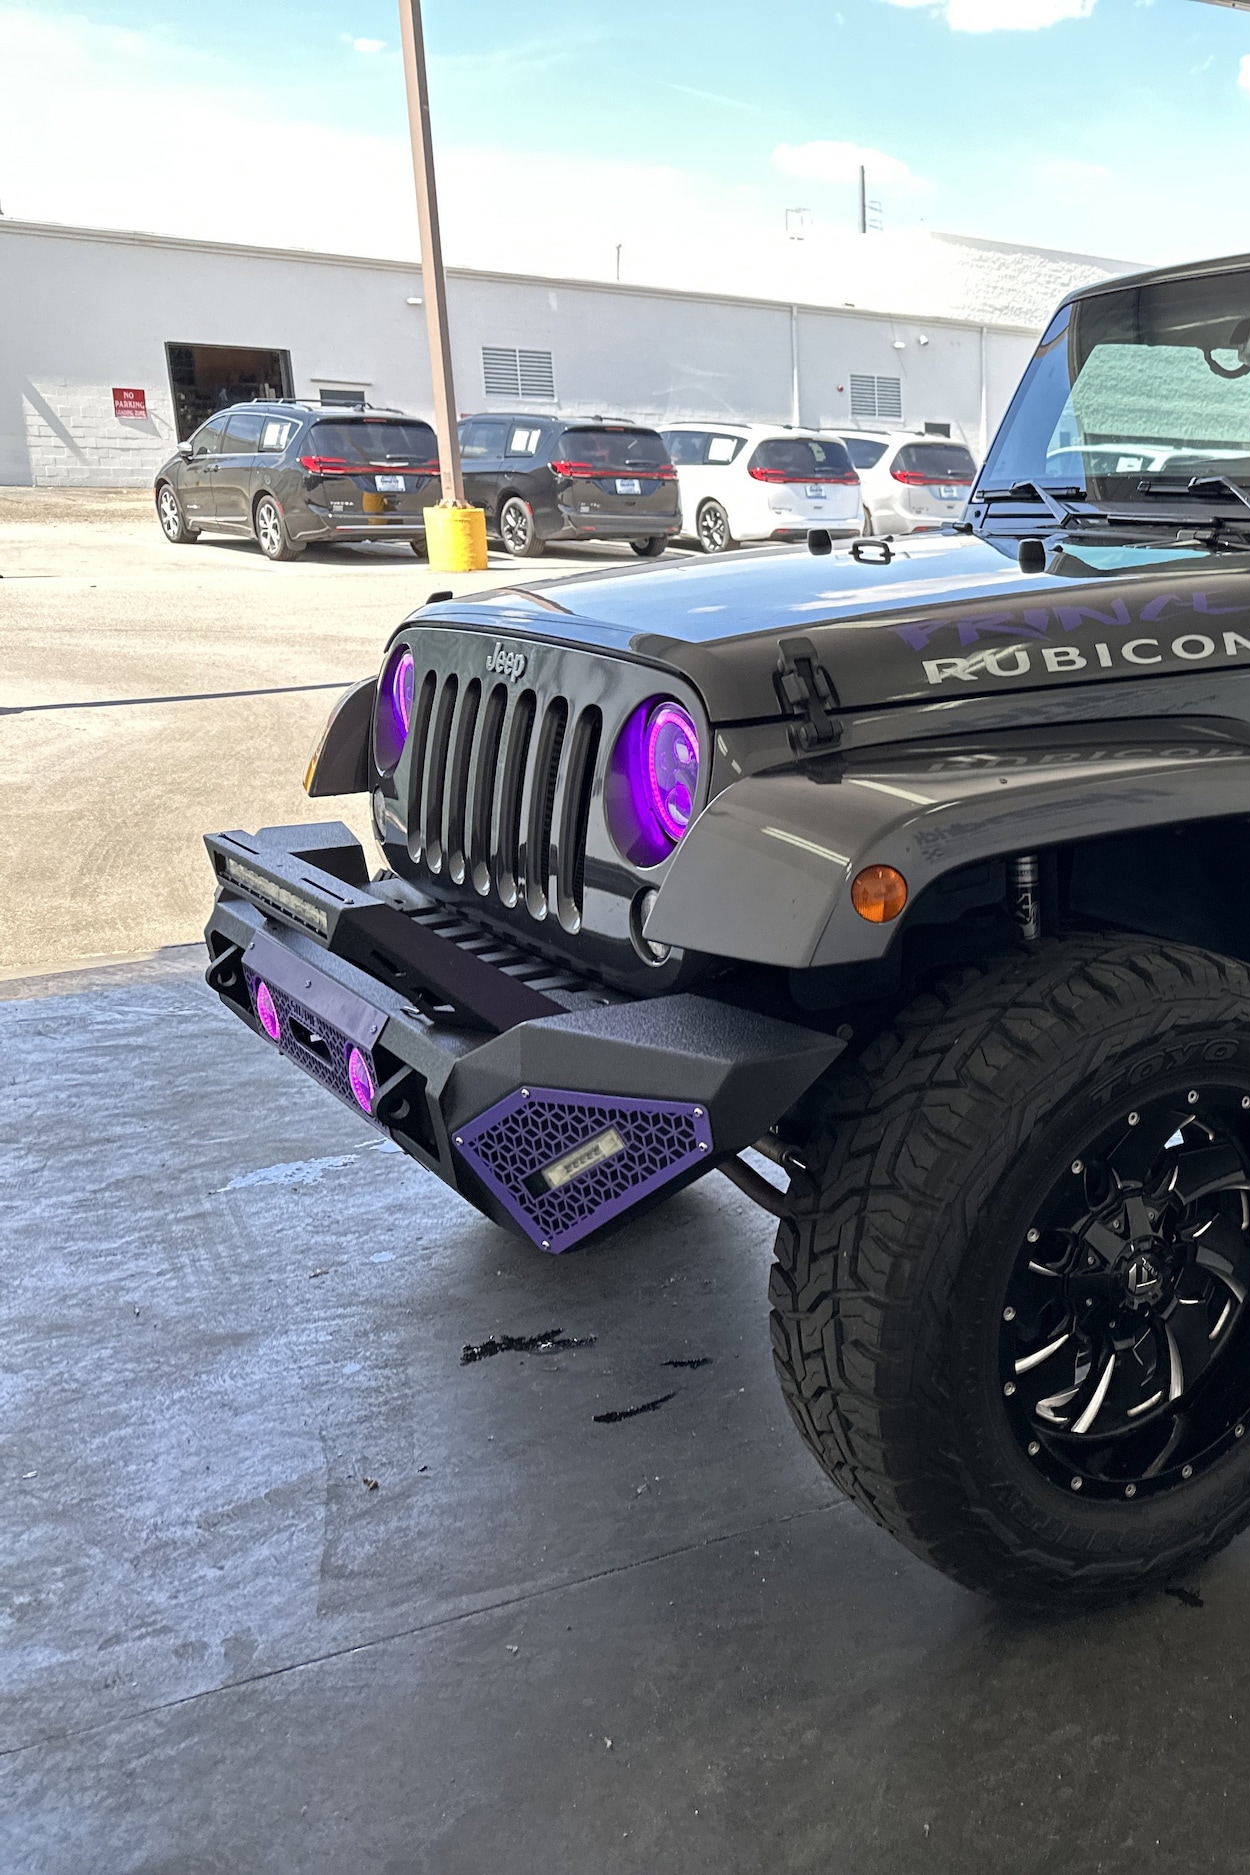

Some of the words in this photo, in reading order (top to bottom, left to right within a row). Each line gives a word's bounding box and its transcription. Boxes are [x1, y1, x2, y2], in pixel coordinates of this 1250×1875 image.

[115, 400, 145, 409] PARKING
[123, 391, 135, 400] NO
[486, 641, 526, 683] Jeep
[1088, 1038, 1240, 1107] TOYO
